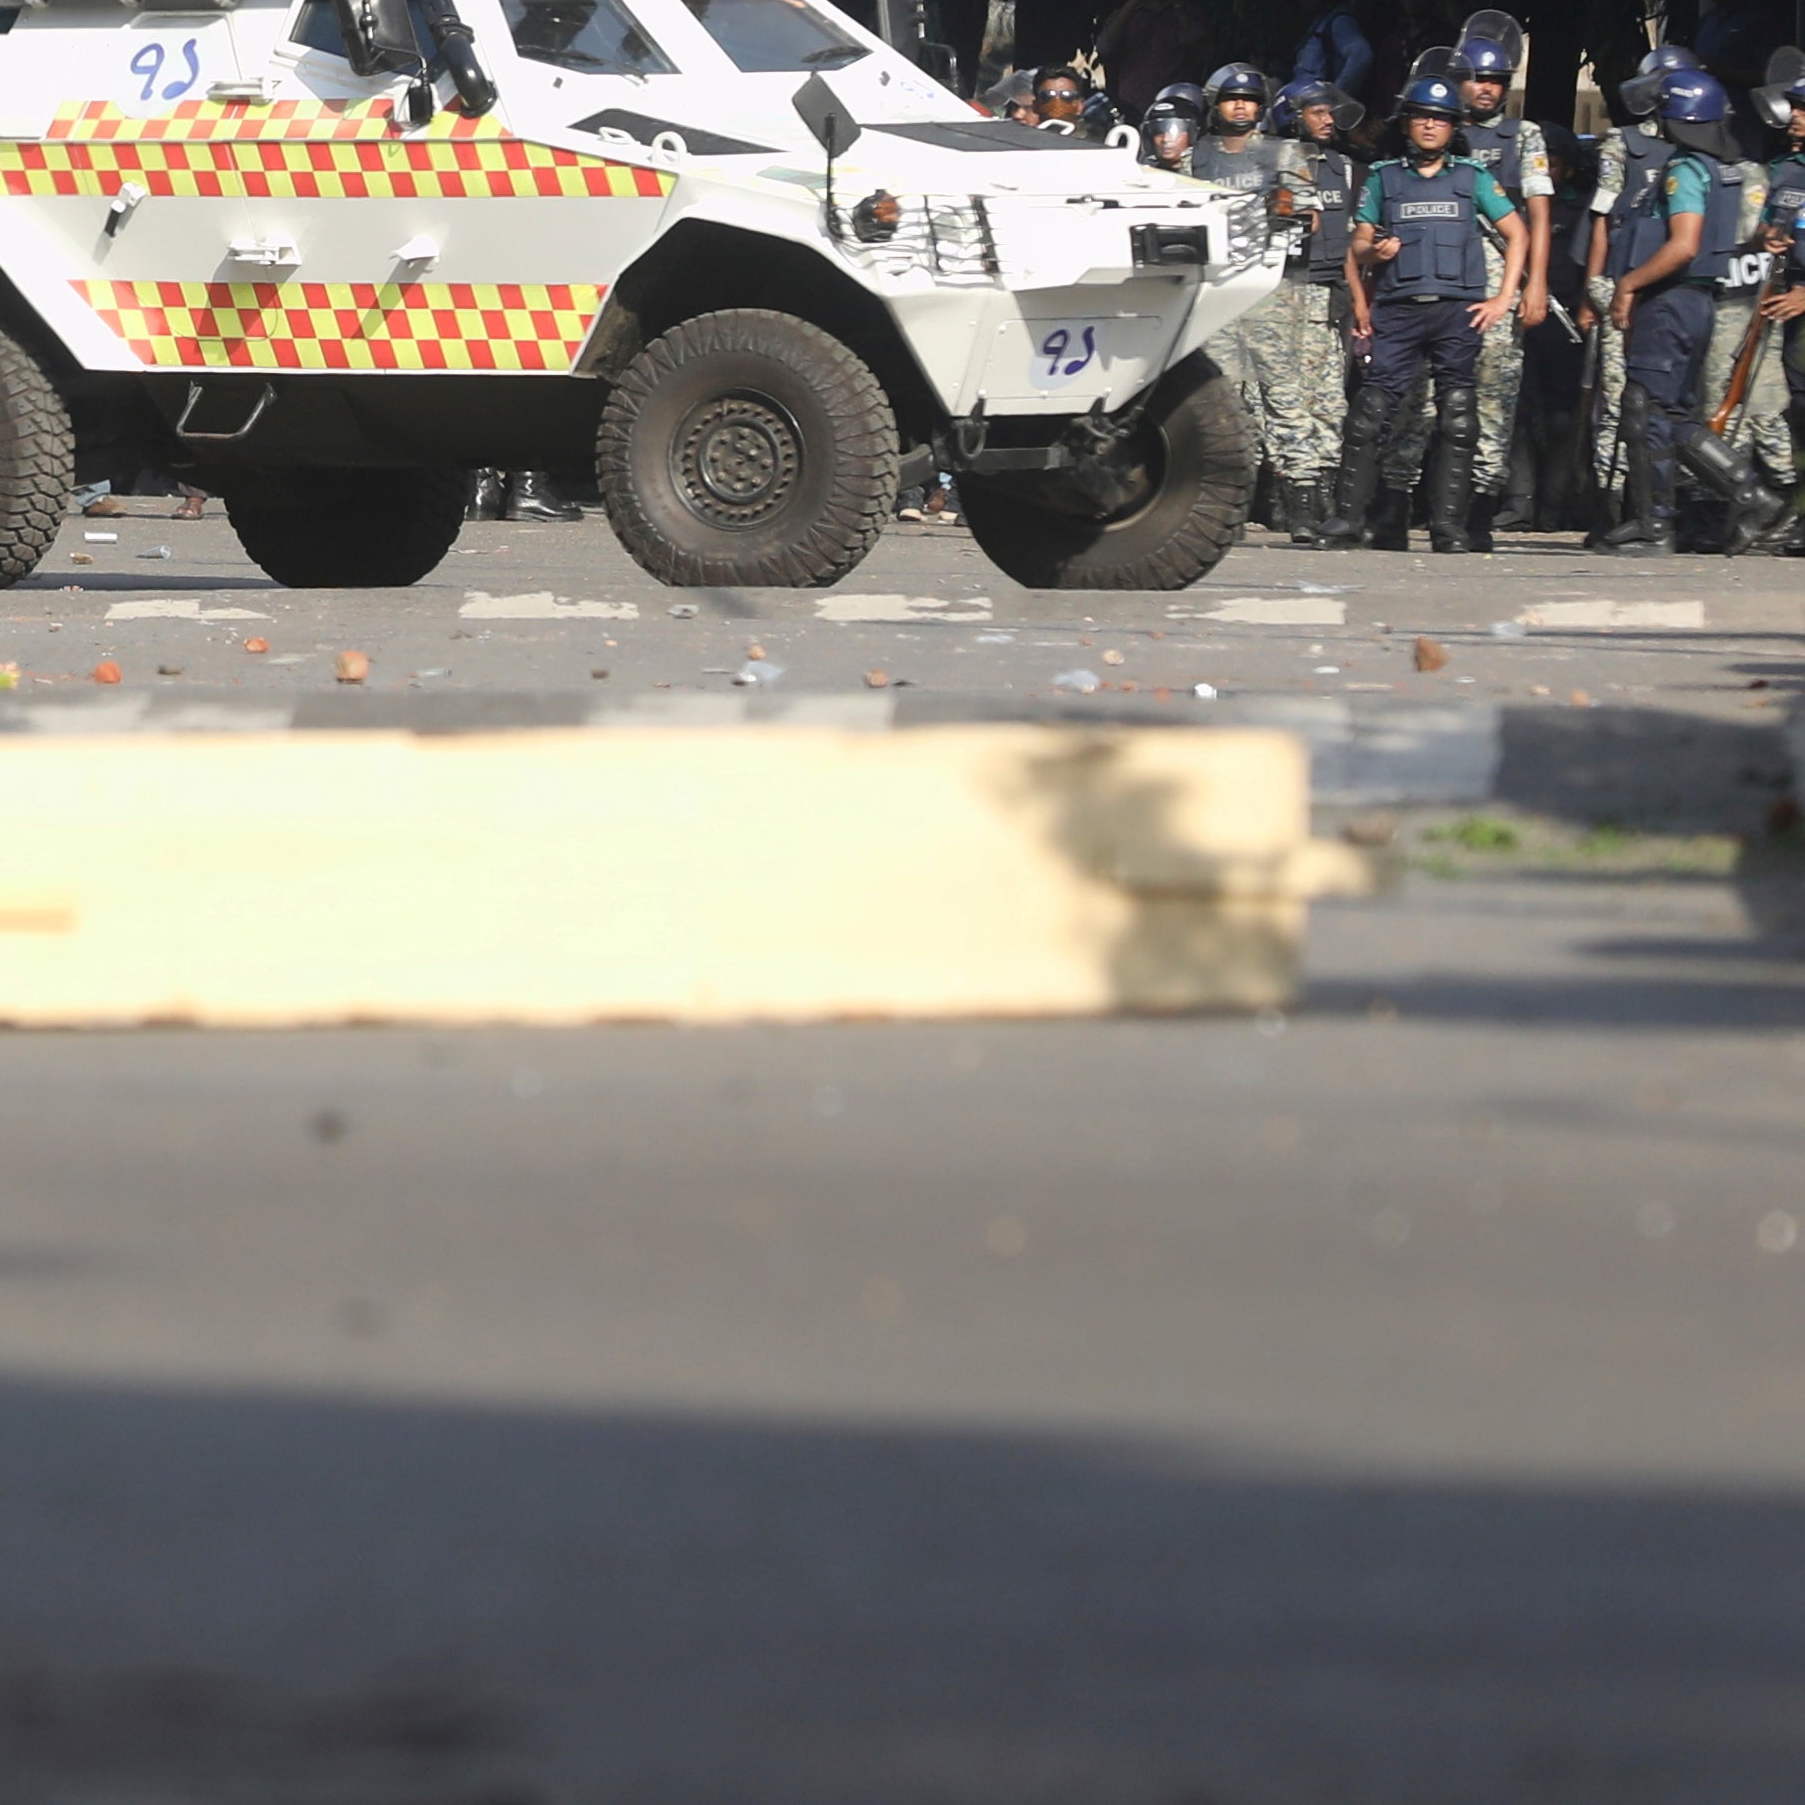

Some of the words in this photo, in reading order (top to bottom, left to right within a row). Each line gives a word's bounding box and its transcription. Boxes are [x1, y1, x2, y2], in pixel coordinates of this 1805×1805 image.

[1471, 148, 1502, 162] ICE
[1214, 173, 1264, 189] OLICE
[1407, 205, 1453, 215] POLICE
